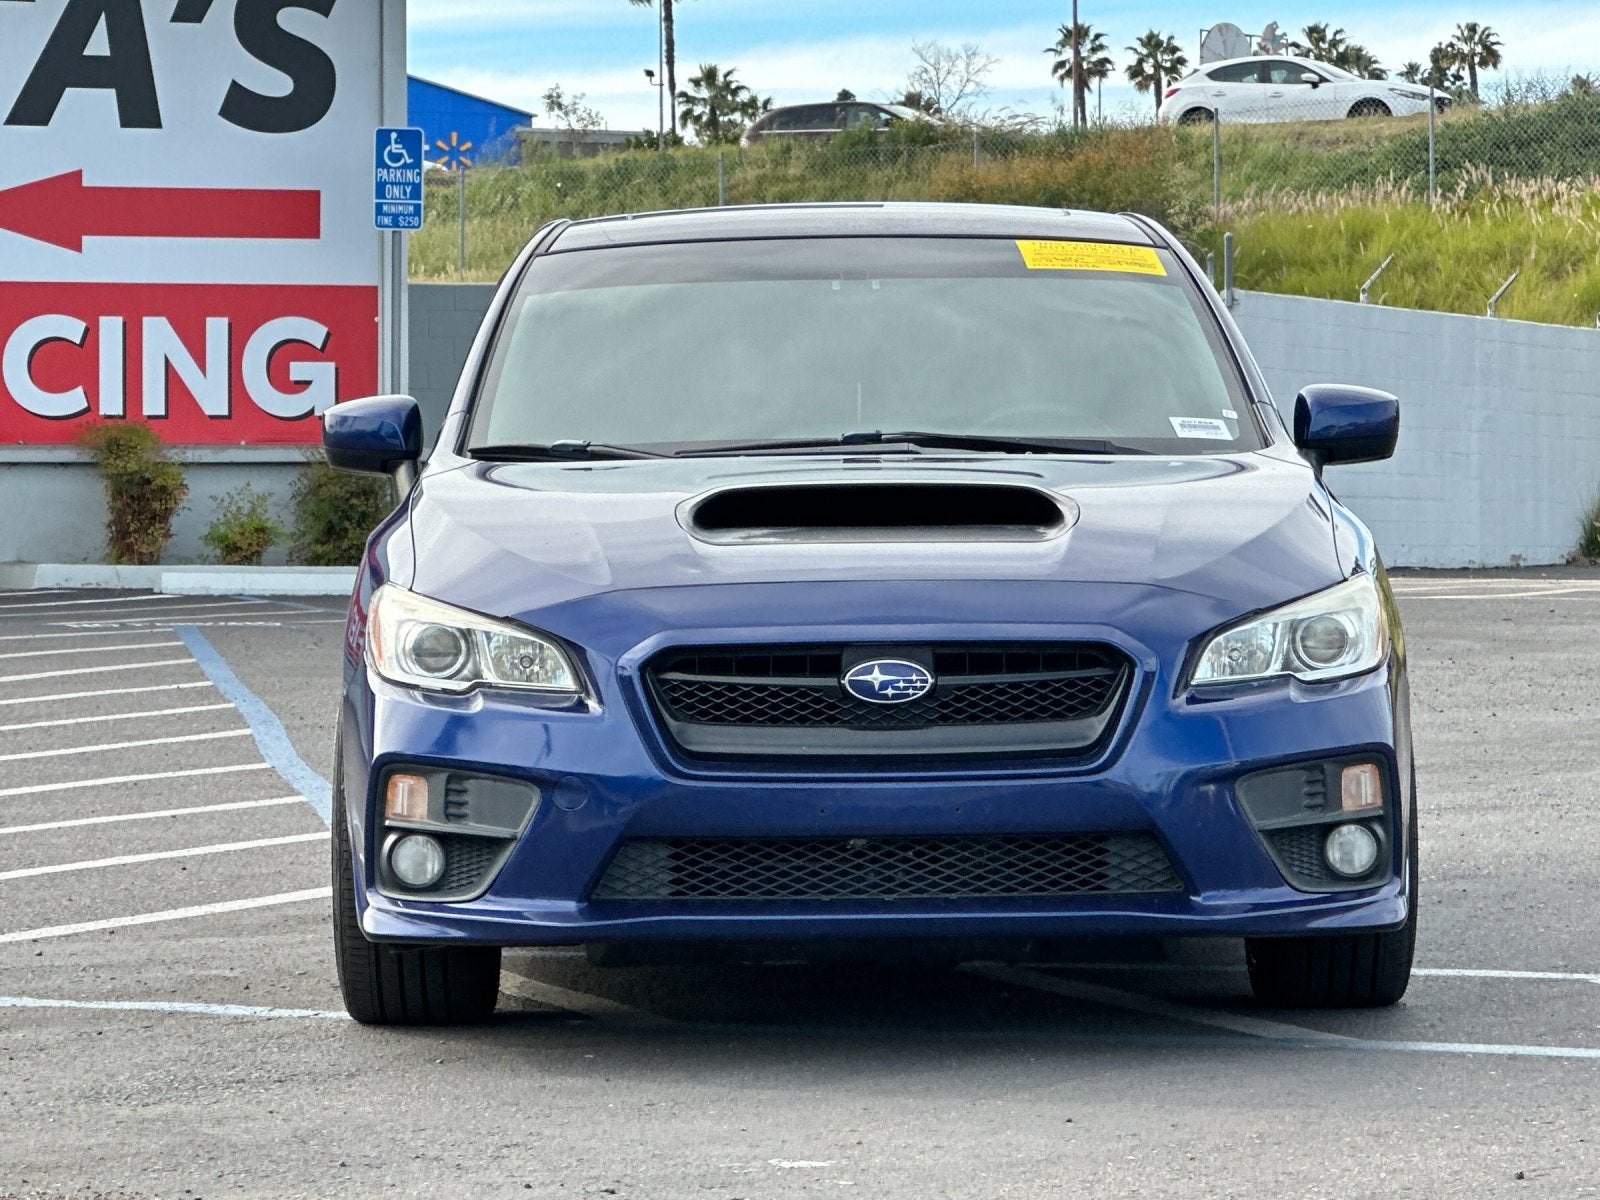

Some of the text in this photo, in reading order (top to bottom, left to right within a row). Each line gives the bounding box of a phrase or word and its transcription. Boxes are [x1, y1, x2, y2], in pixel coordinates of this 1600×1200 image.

[0, 0, 337, 134] A'S
[377, 168, 421, 184] PARKING
[385, 184, 412, 199] ONLY
[382, 204, 414, 215] MINIMUM
[377, 216, 420, 227] FINE $250
[2, 314, 339, 421] CING
